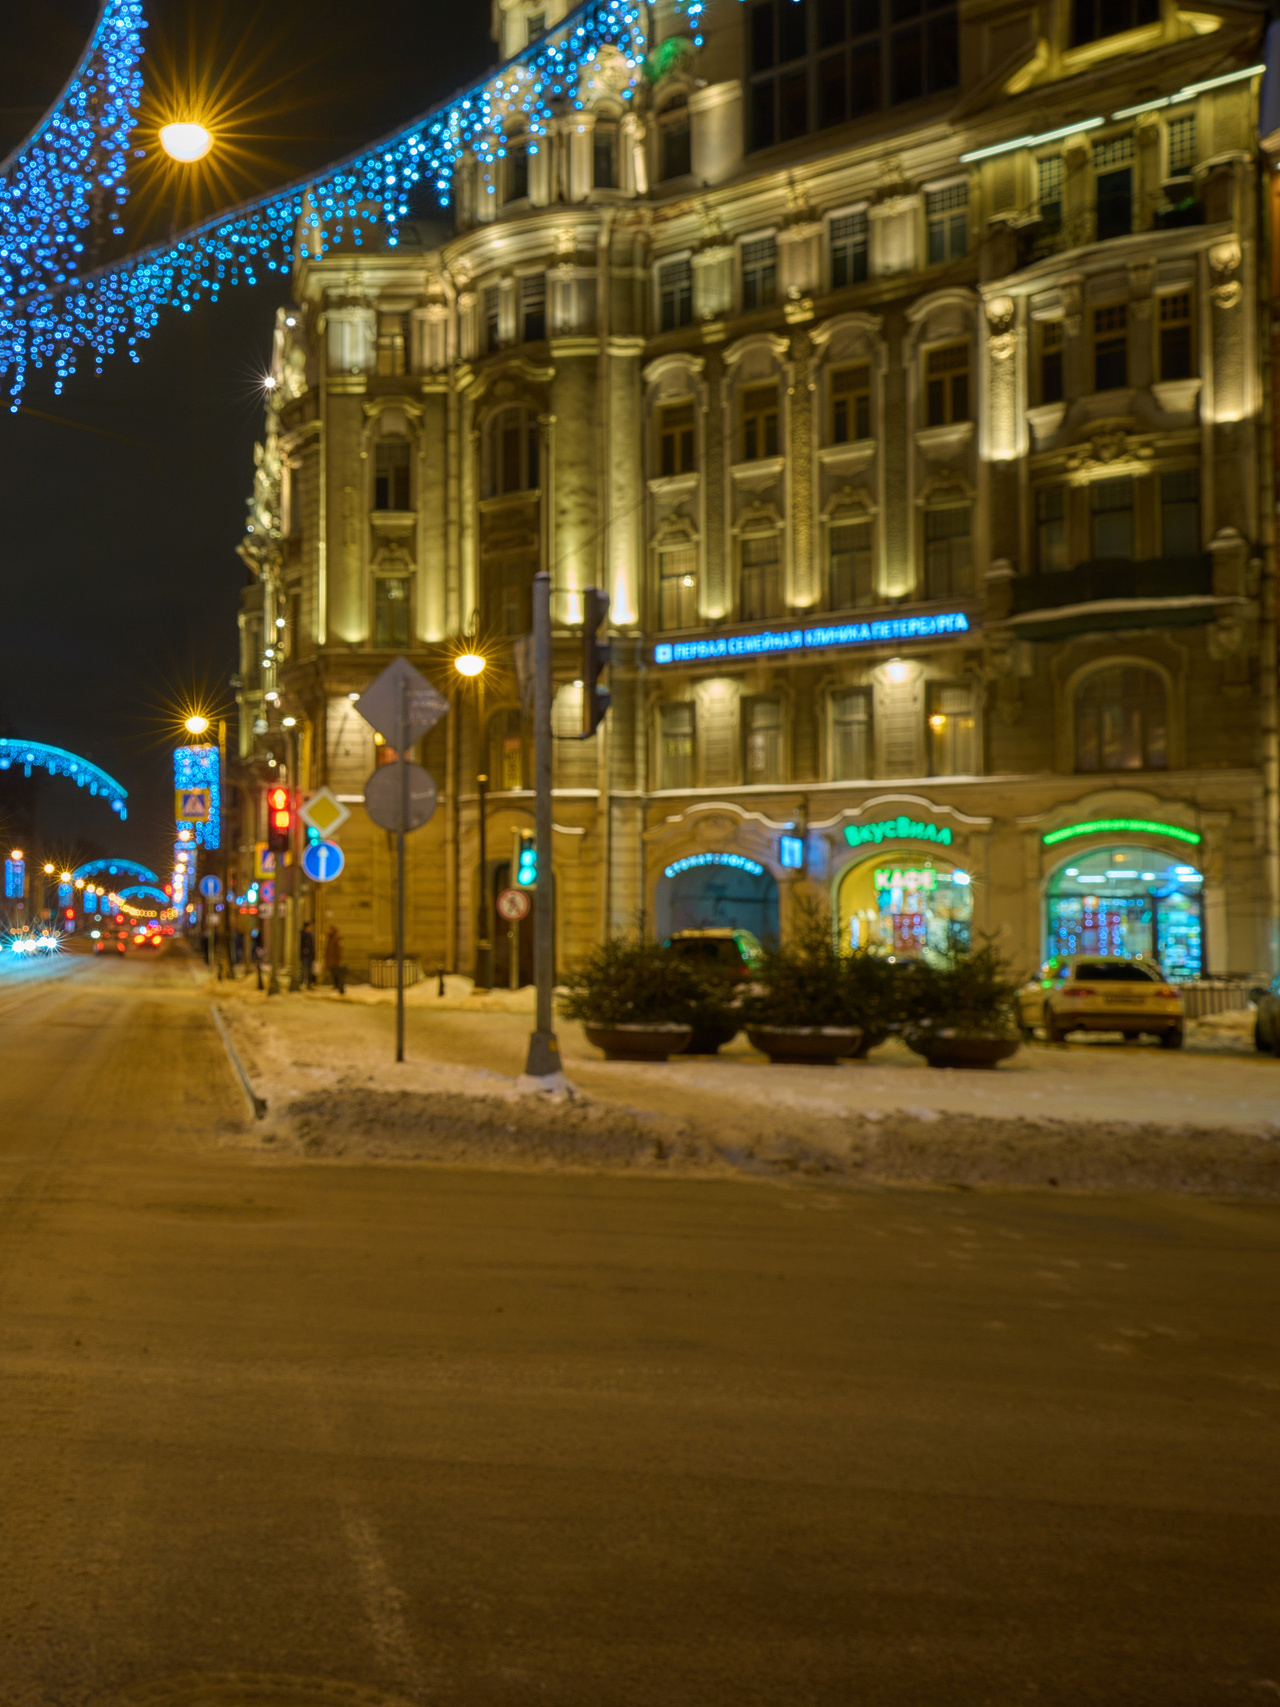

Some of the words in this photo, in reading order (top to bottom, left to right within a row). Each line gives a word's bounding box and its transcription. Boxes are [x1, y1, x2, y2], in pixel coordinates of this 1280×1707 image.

[673, 638, 727, 661] ПЕРВАЯ
[727, 630, 803, 655] СЕМЕЙНАЯ
[804, 622, 871, 647] КЛИНИКА
[874, 869, 938, 891] КАФЕ
